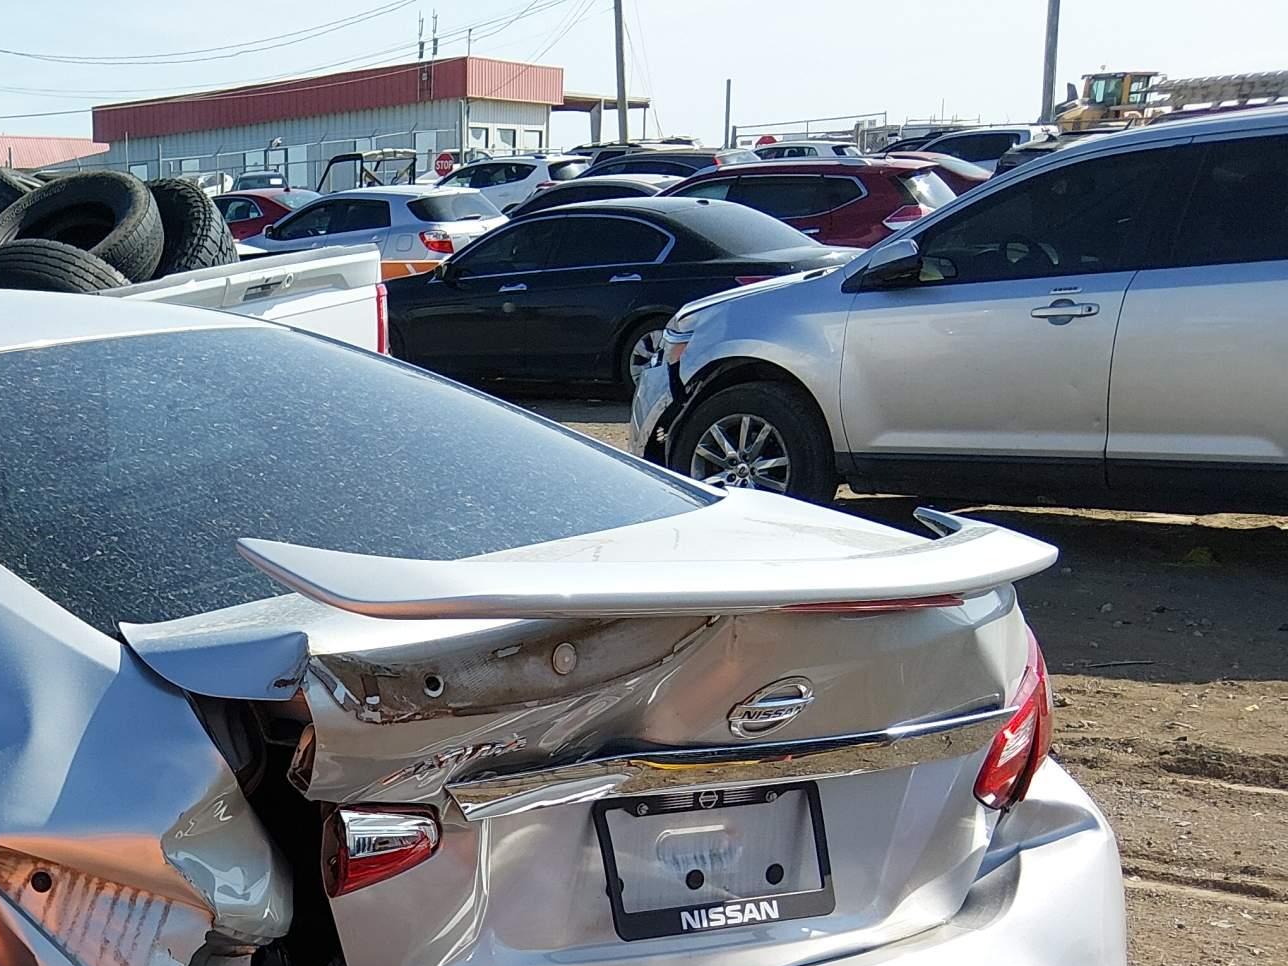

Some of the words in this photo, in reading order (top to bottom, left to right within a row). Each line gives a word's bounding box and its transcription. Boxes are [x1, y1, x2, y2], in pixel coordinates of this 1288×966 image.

[435, 160, 454, 170] STOP
[740, 704, 806, 720] NISSAN
[680, 900, 780, 930] NISSAN
